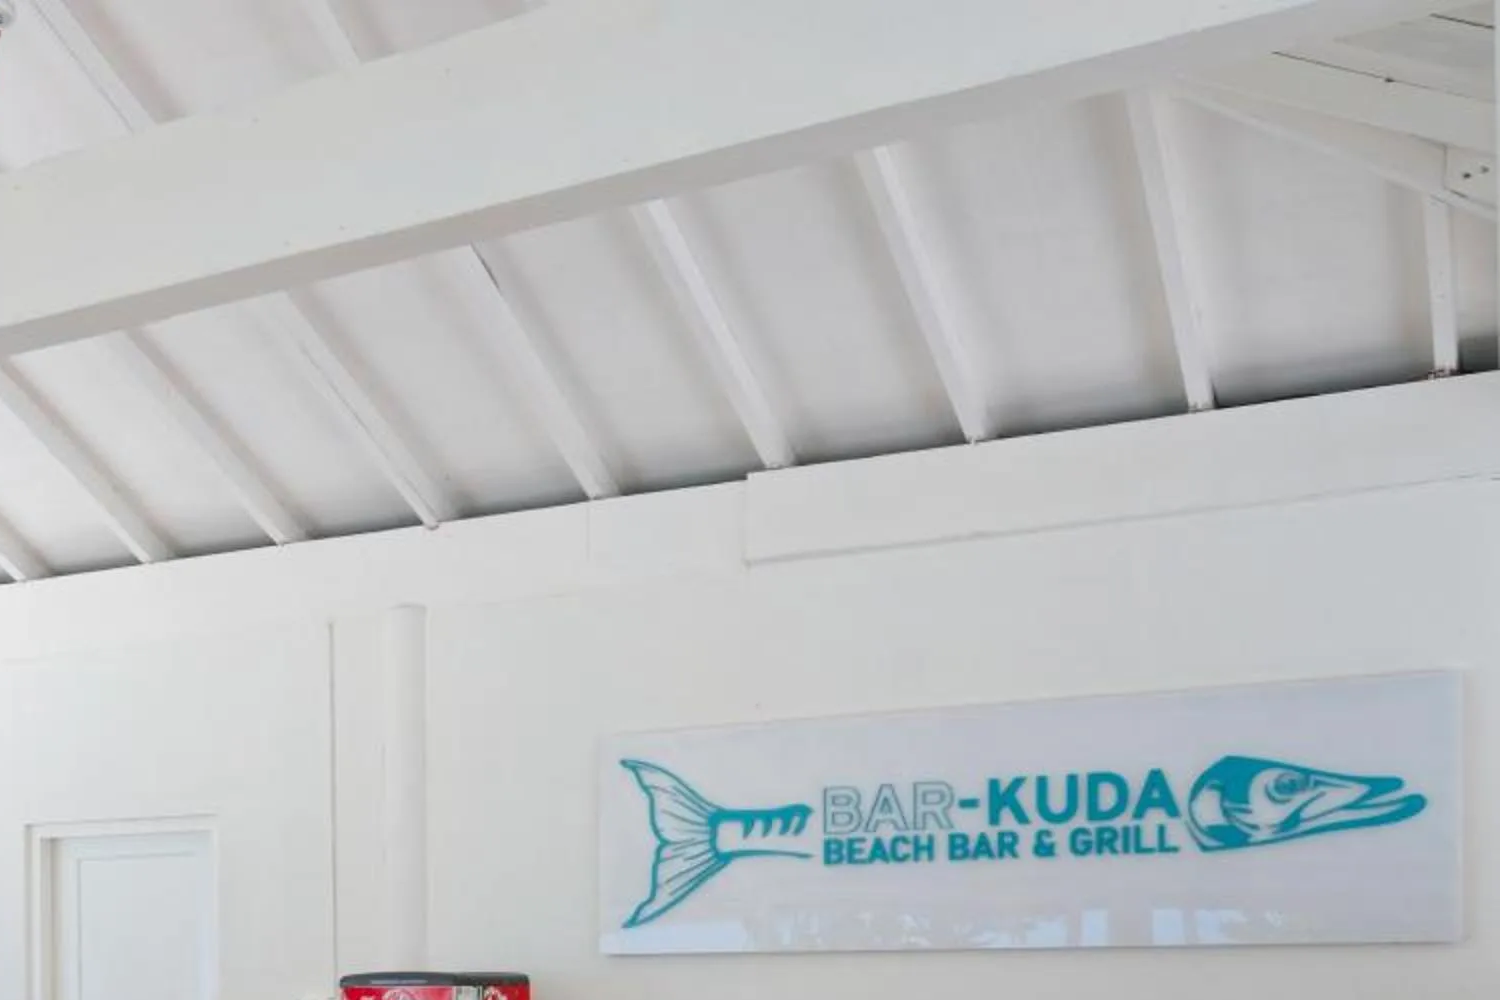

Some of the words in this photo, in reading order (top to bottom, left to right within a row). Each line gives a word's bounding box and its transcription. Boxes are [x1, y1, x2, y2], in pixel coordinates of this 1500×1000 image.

[822, 767, 1181, 834] BAR-KUDA
[822, 834, 936, 867] BEACH
[947, 830, 1020, 862] BAR
[1031, 828, 1057, 859] &
[1068, 823, 1181, 858] GRILL
